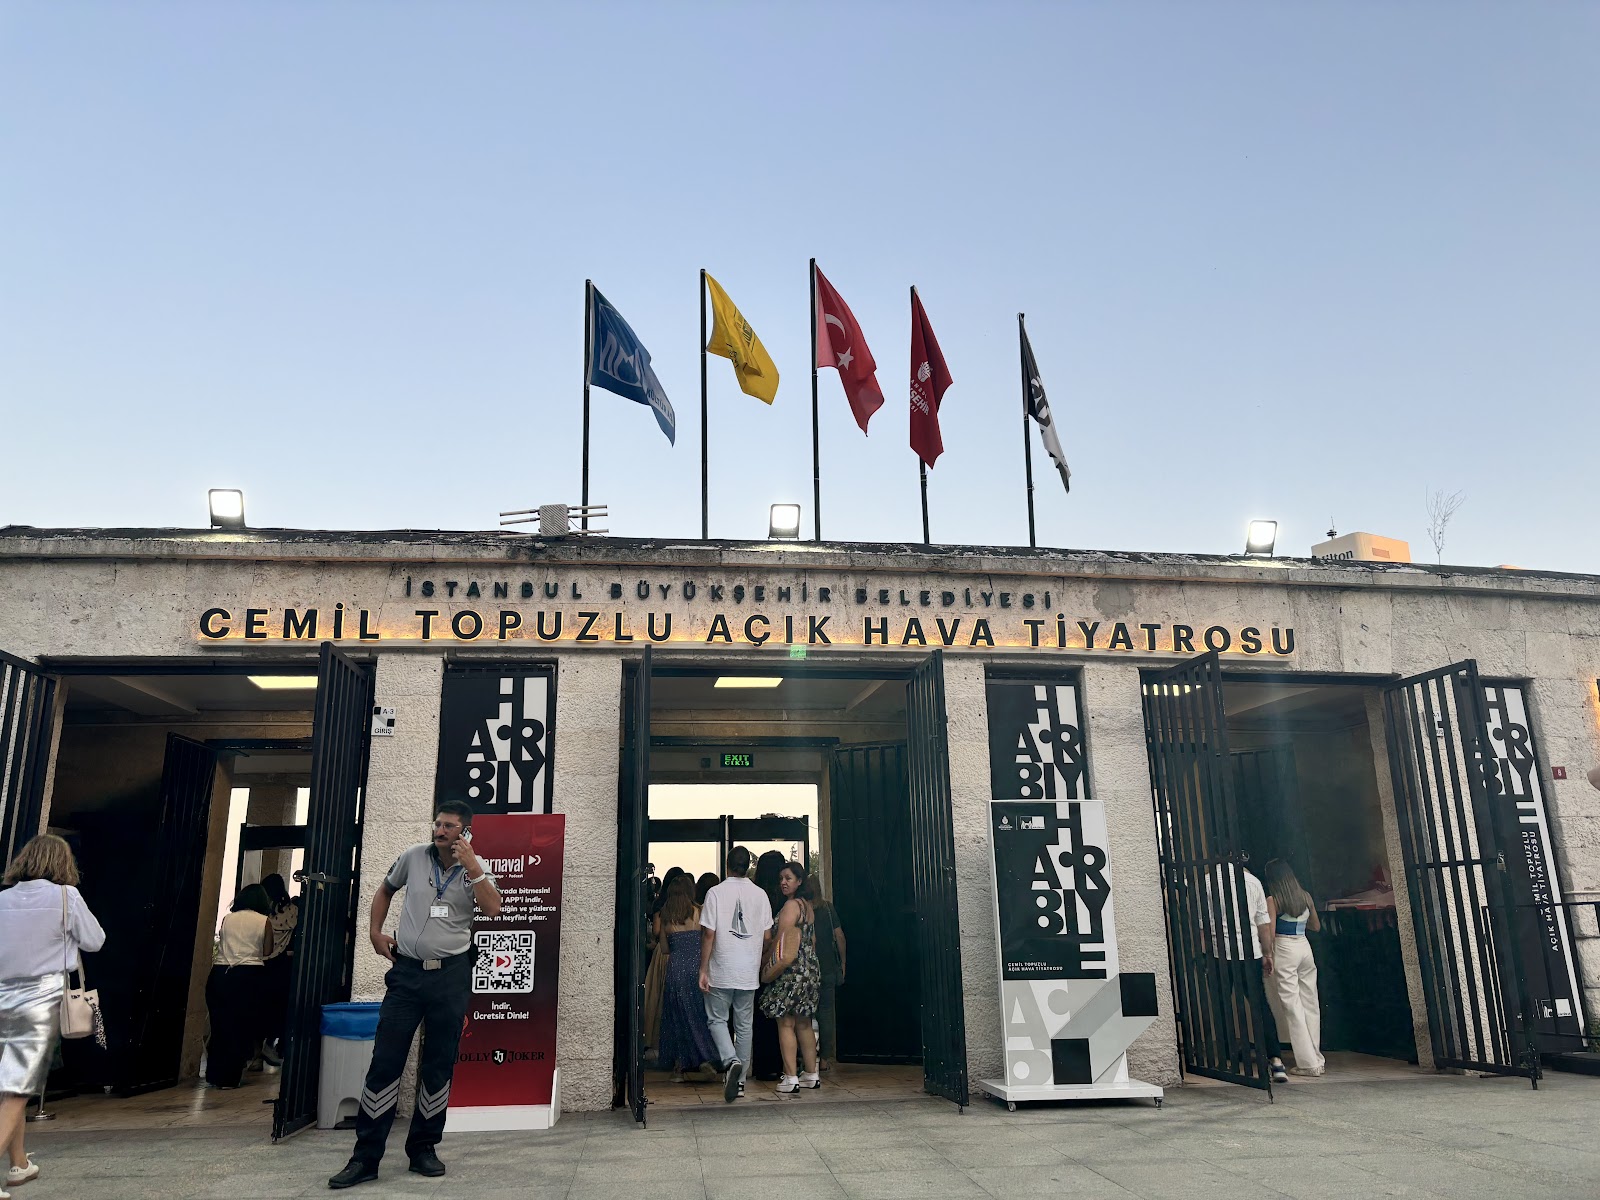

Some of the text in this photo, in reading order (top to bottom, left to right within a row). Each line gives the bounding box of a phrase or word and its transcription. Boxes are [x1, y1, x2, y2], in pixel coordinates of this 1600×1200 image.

[1321, 550, 1354, 560] ilton
[406, 577, 1051, 609] İSTANBUL BÜYÜKŞEHİR BELEDİYESİ
[200, 603, 1295, 655] CEMİL TOPUZLU AÇIK HAVA TİYATROSU
[1521, 831, 1537, 879] TOPUZLU
[491, 1000, 512, 1010] İndir,
[473, 1010, 530, 1020] Ücretsiz Dinle!
[507, 1051, 545, 1063] JOKER
